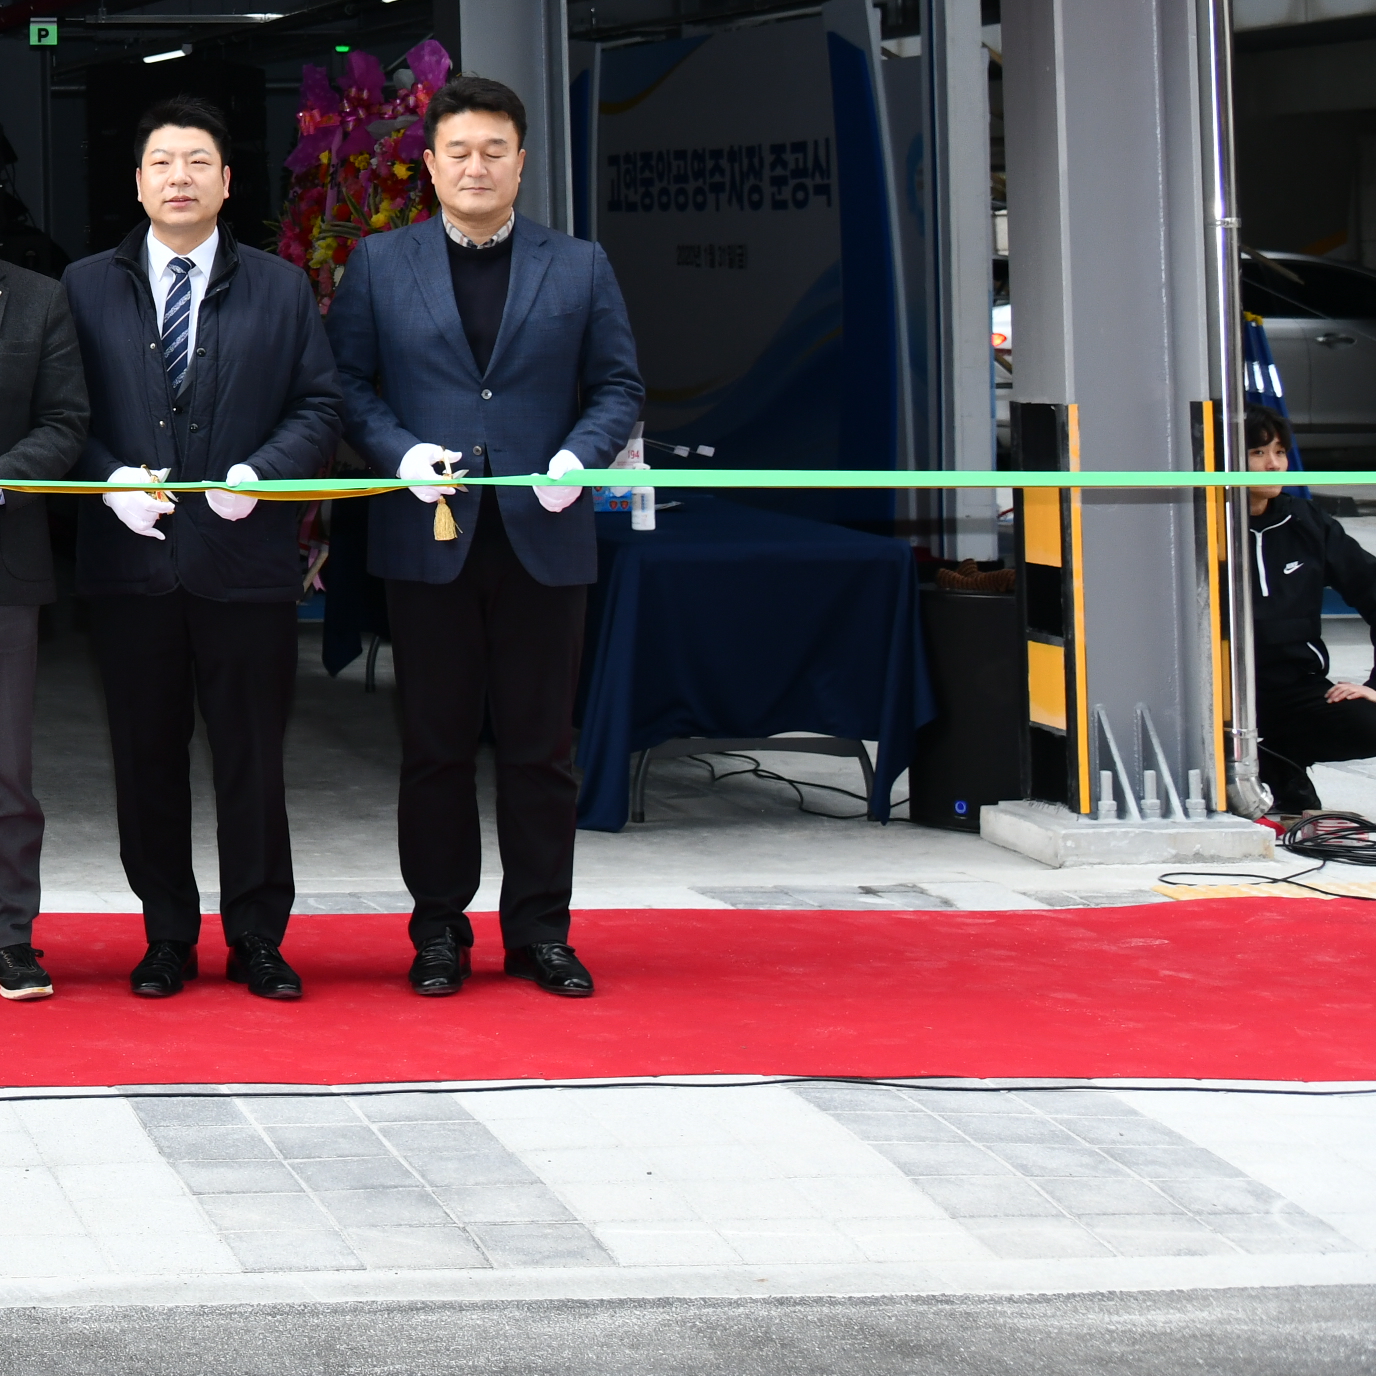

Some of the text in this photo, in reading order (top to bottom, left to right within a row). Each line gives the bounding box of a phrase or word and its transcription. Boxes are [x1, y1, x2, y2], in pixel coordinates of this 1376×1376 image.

[38, 27, 50, 43] P
[607, 137, 832, 212] 고현중앙공영주차장 준공식
